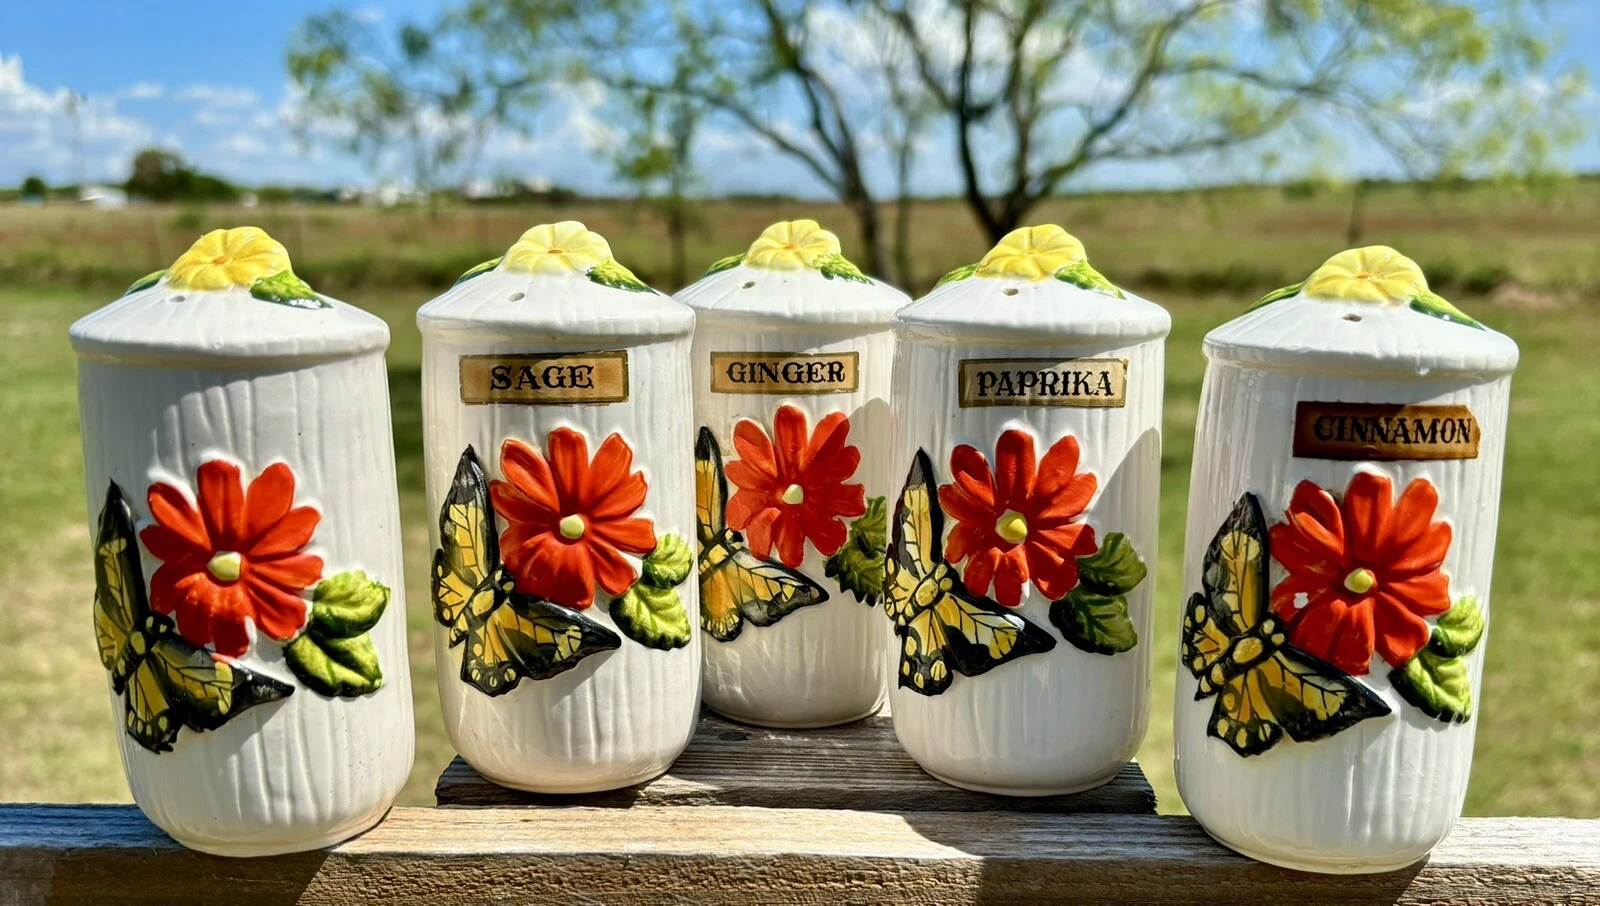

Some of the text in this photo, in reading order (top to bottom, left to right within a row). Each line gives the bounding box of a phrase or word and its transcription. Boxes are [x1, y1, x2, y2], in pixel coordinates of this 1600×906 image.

[490, 365, 595, 391] SAGE
[726, 361, 846, 384] GINGER
[976, 370, 1115, 396] PAPRIKA
[1313, 415, 1472, 444] CINNAMON
